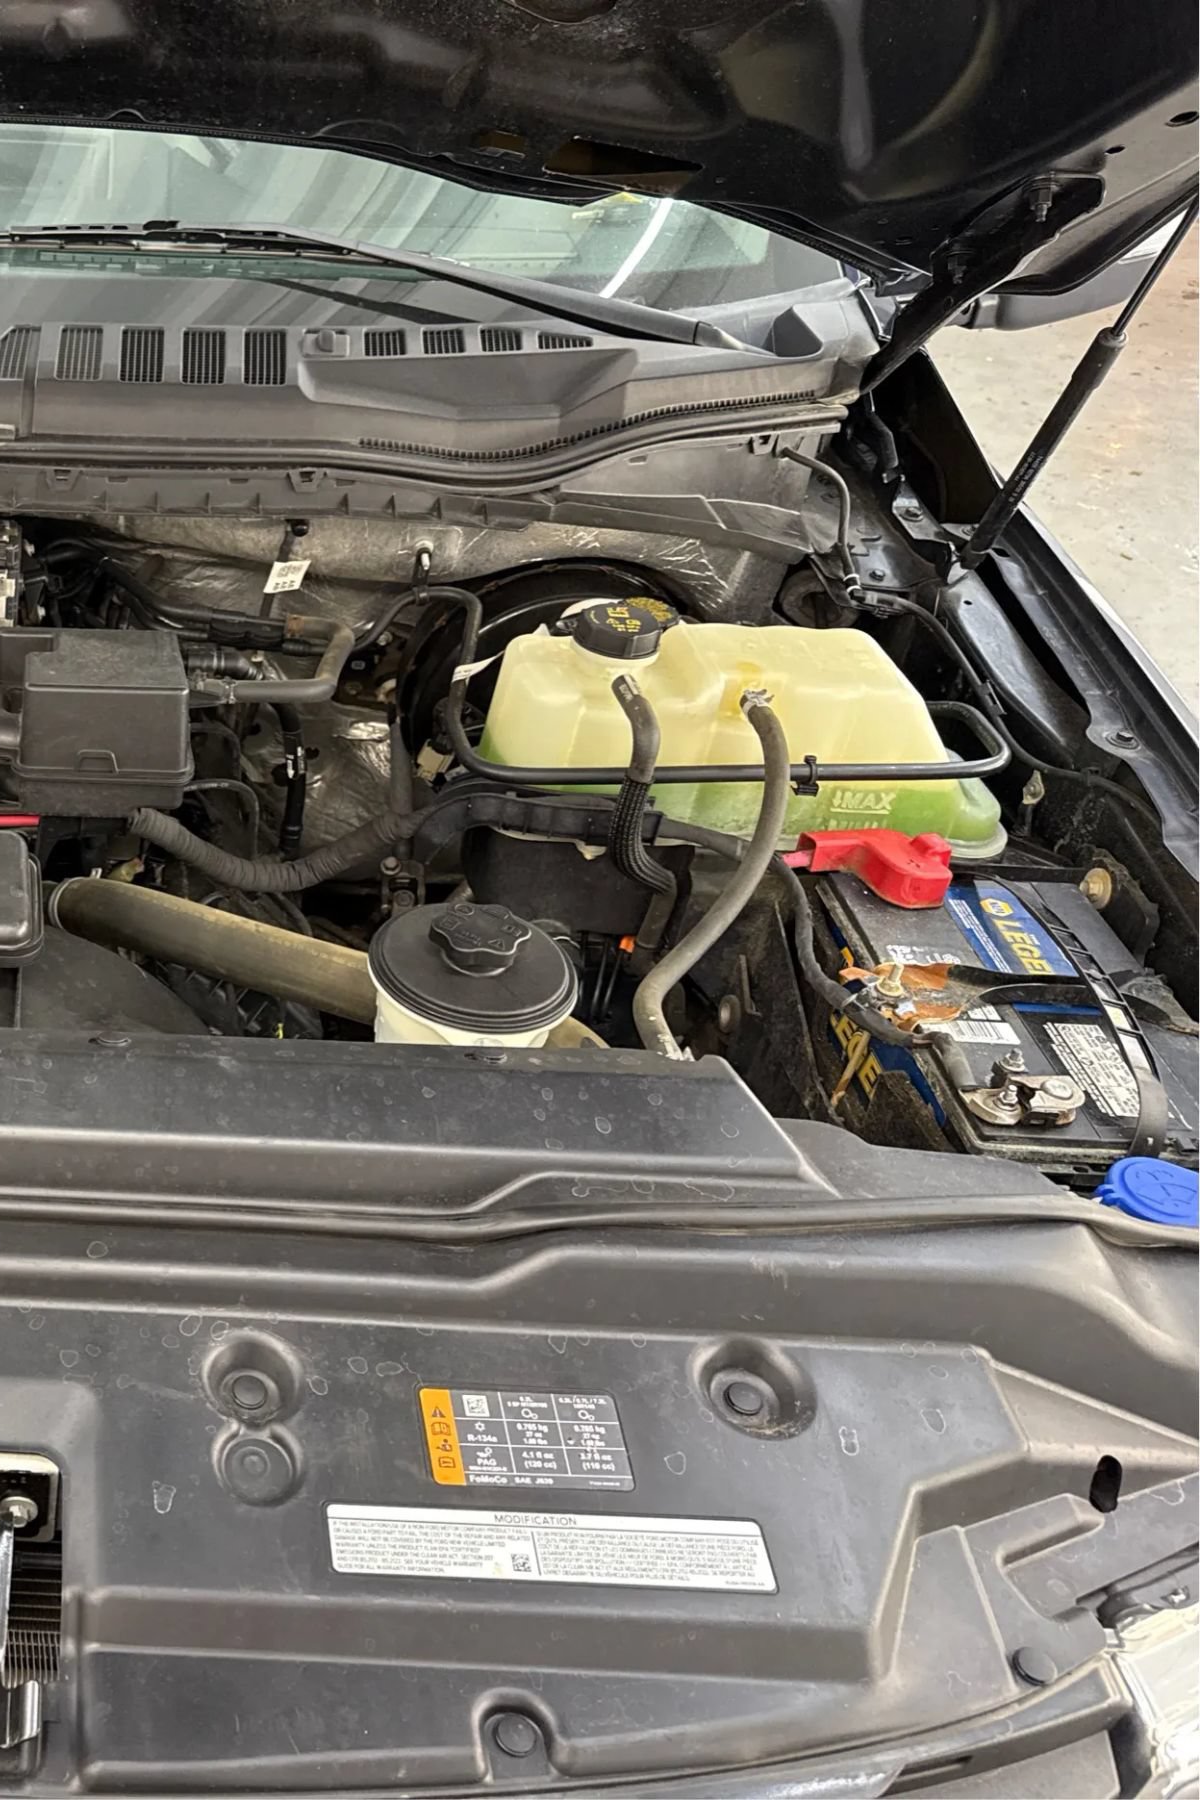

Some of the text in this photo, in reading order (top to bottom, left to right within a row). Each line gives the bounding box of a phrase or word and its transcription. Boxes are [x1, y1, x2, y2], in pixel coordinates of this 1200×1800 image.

[841, 790, 897, 810] MAX
[992, 918, 1057, 975] LEGE
[537, 1423, 548, 1433] kg
[595, 1425, 606, 1435] kg
[467, 1434, 498, 1442] R-134a
[476, 1458, 497, 1466] PAG
[524, 1460, 558, 1470] (120 cc)
[582, 1461, 616, 1472] (110 cc)
[468, 1475, 508, 1483] FoMoCo
[494, 1514, 577, 1527] MODIFICATION
